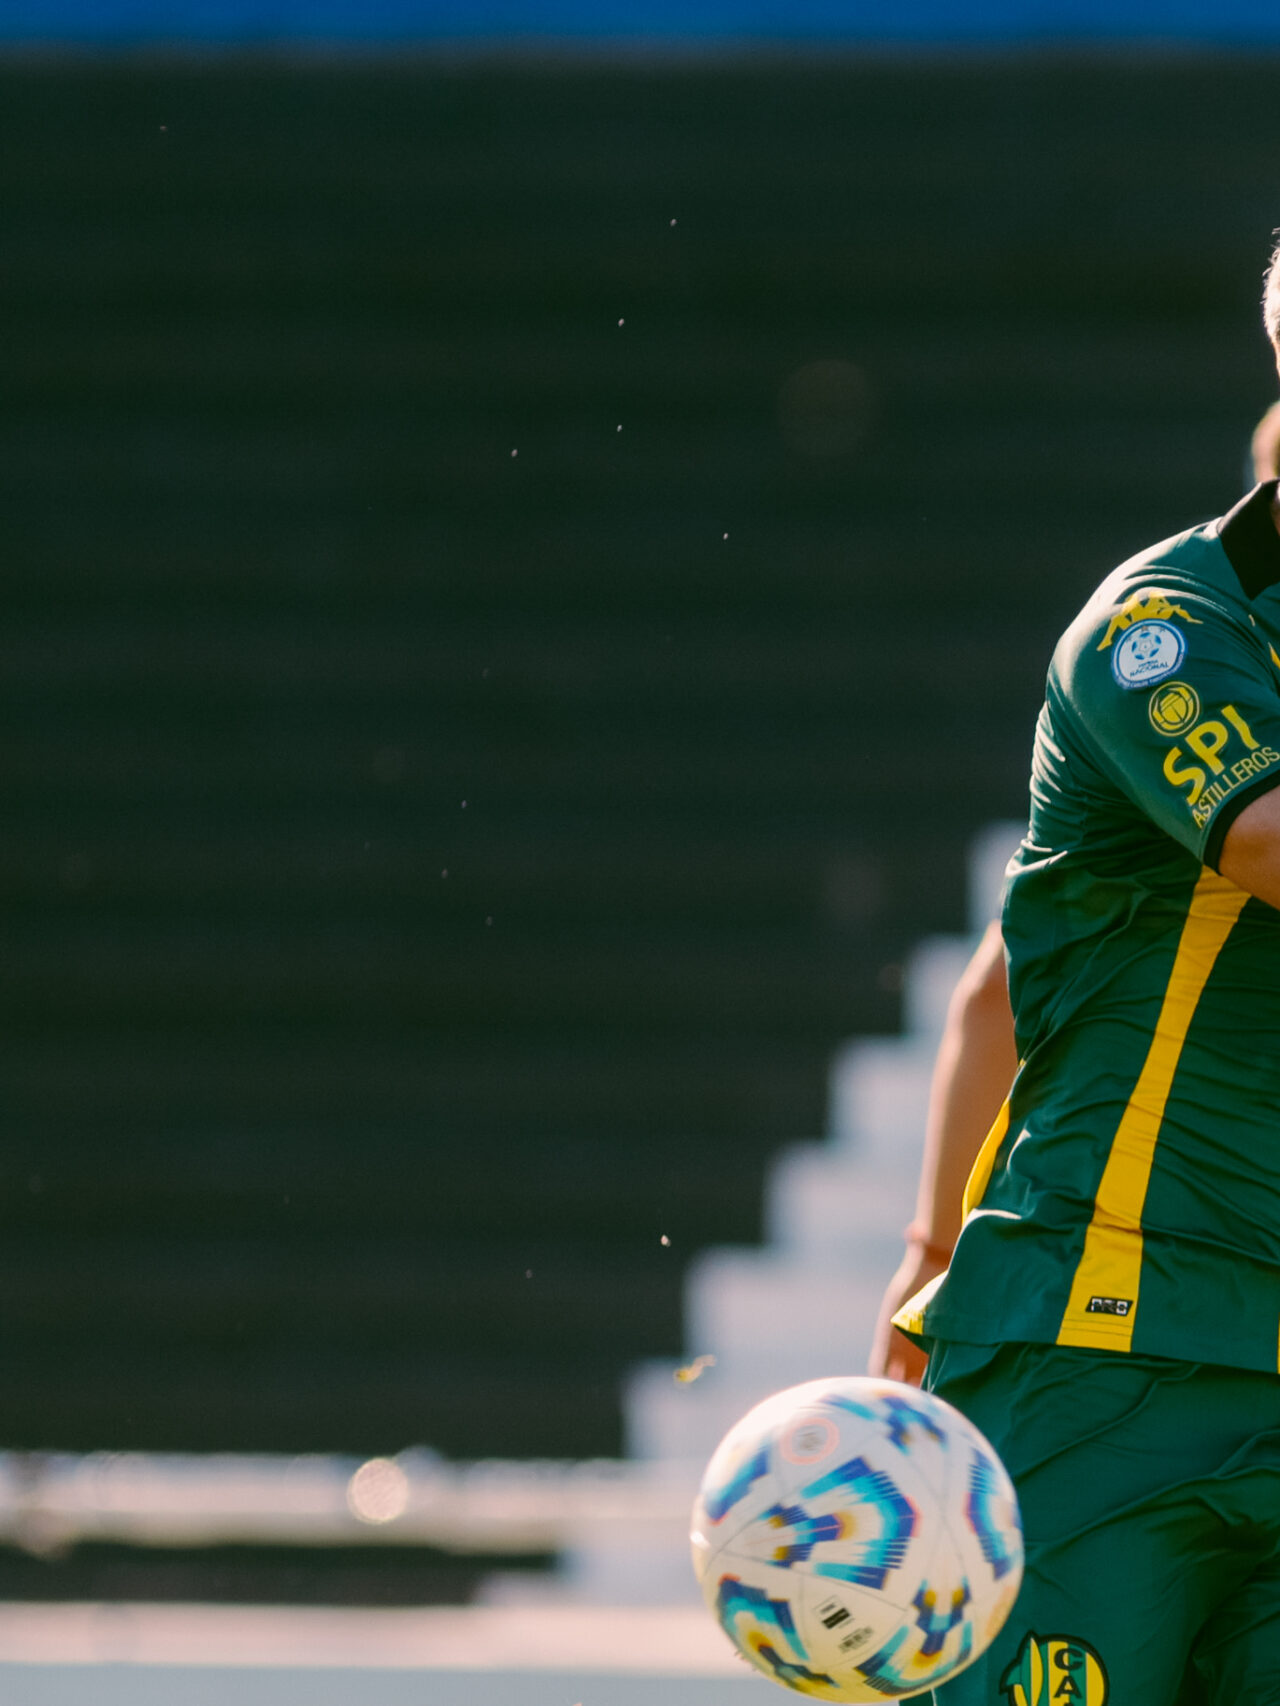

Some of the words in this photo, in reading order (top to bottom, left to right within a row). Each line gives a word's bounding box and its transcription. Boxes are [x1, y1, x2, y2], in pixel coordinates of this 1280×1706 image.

[1163, 704, 1260, 807] SPI
[1192, 746, 1280, 829] ASTILLEROS
[1053, 1648, 1083, 1706] CA
